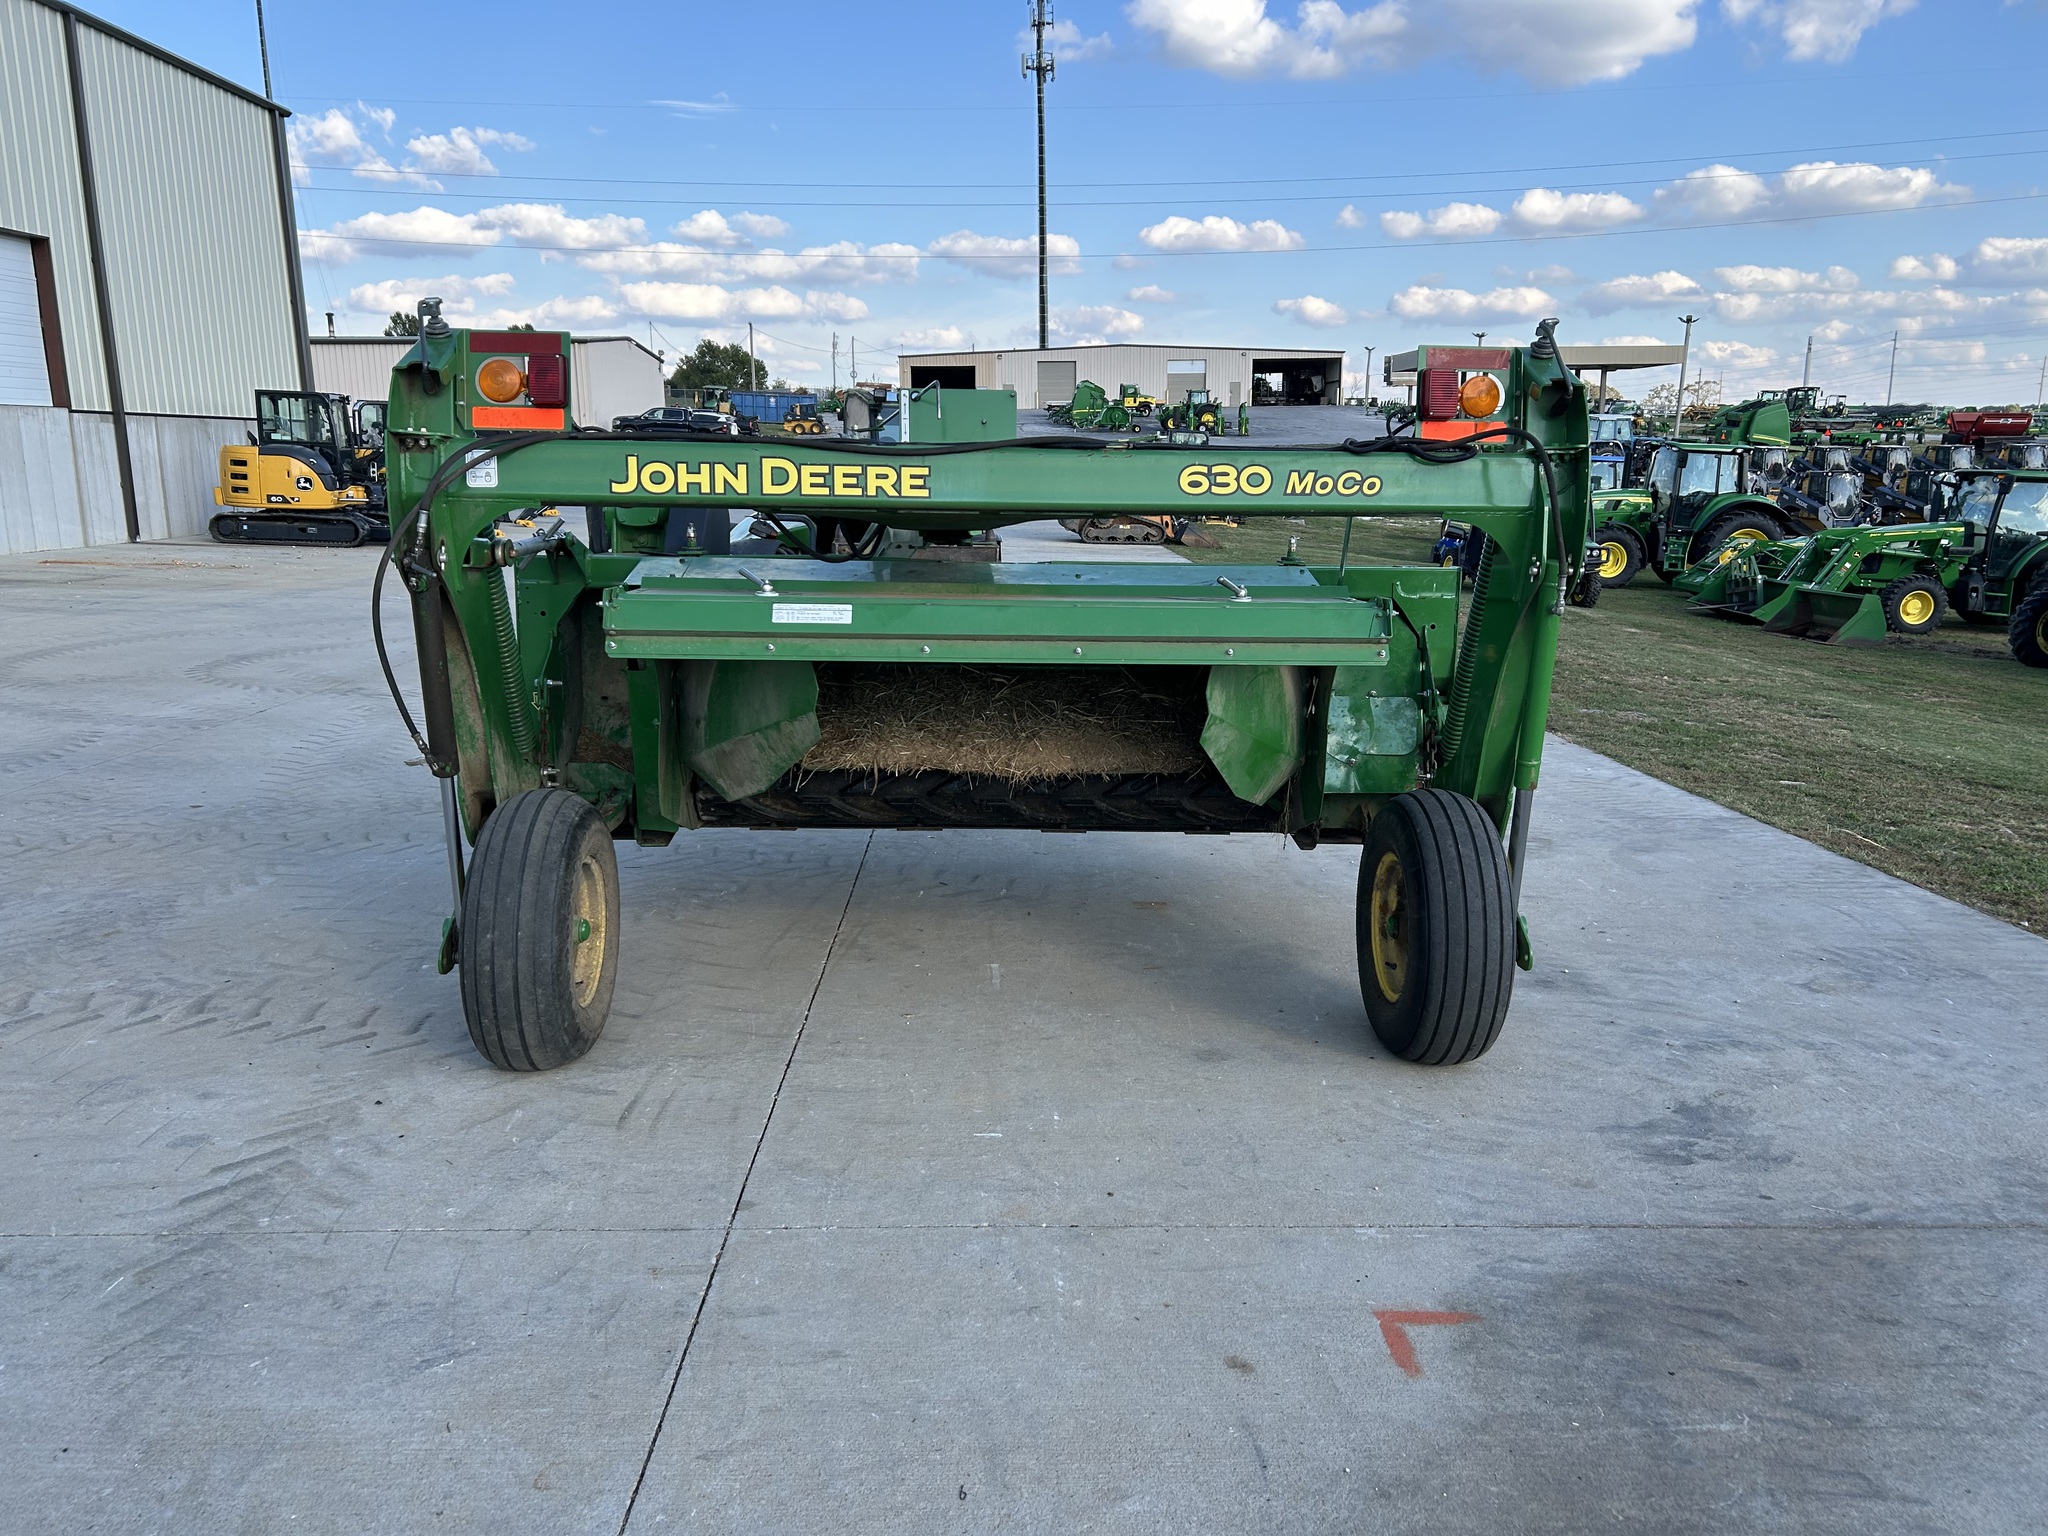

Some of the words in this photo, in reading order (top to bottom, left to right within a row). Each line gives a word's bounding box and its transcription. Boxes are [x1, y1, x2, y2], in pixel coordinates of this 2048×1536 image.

[610, 454, 749, 496] JOHN
[760, 456, 931, 498] DEERE
[1178, 463, 1273, 496] 630
[1283, 469, 1383, 497] MoCo
